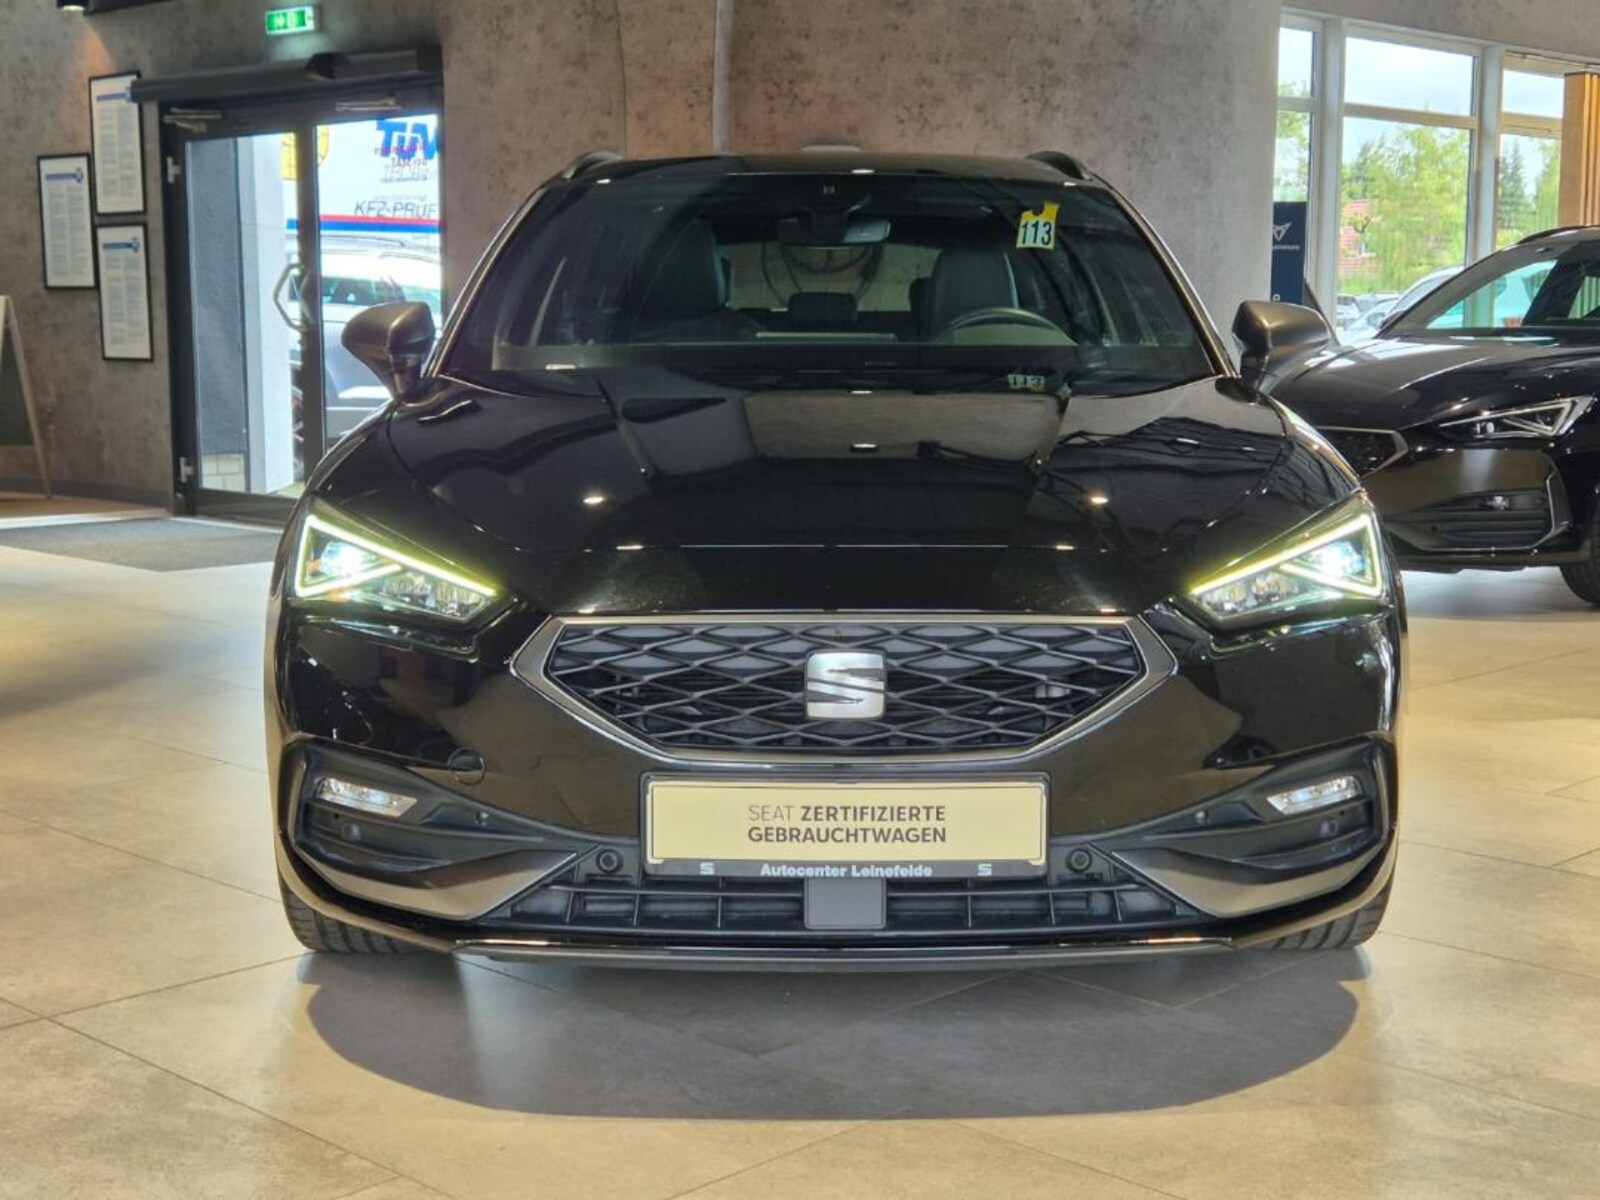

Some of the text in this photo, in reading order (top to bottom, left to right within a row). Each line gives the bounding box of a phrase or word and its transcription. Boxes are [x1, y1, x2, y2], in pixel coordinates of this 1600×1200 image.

[1021, 219, 1052, 246] 113
[748, 804, 946, 822] SEAT ZERTIFIZIERTE
[747, 826, 947, 843] GEBRAUCHTWAGEN
[759, 862, 849, 877] Autocenter
